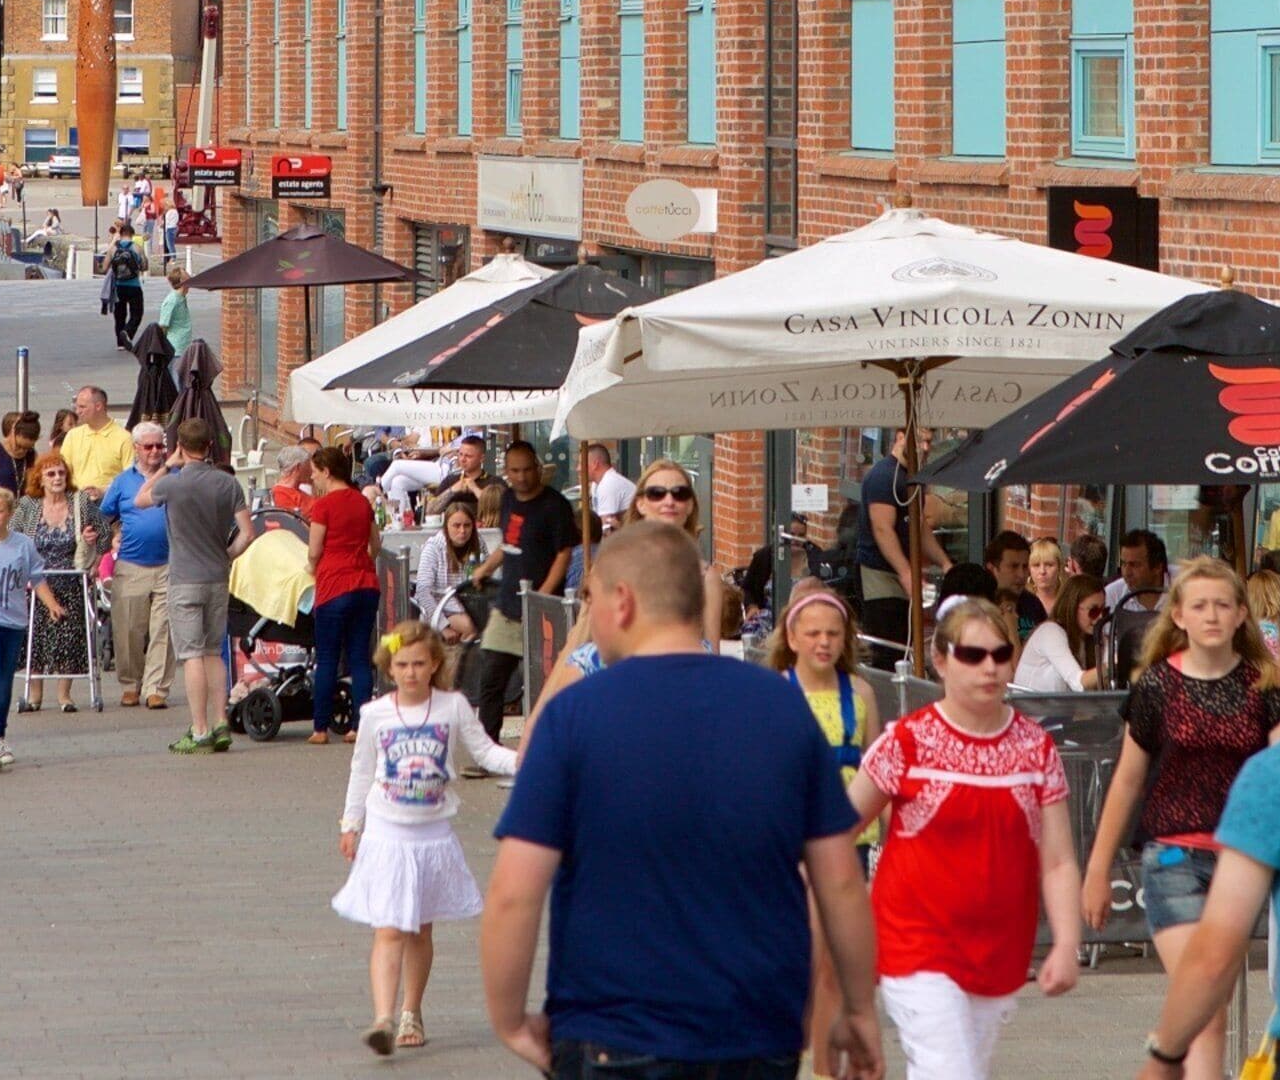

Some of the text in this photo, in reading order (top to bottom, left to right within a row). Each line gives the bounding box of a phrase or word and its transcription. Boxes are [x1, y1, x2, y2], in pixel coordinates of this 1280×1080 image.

[214, 170, 235, 178] agents
[301, 181, 324, 190] agents
[867, 336, 1042, 350] VINTNERS SINCE 1821
[405, 410, 467, 421] VINTNERS
[471, 409, 506, 420] SINCE
